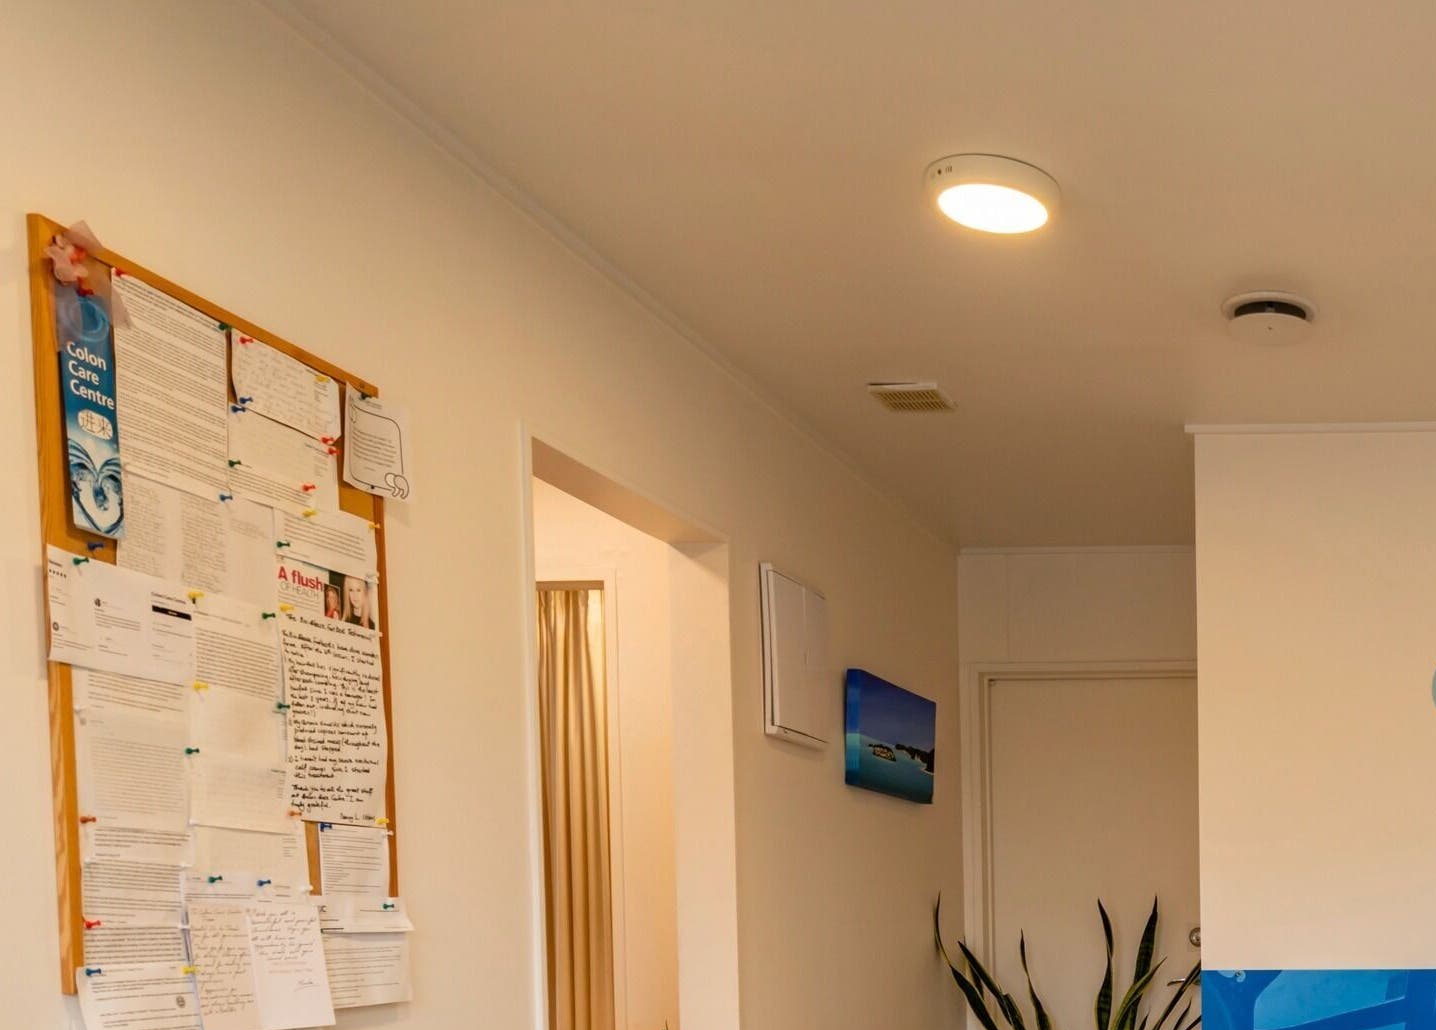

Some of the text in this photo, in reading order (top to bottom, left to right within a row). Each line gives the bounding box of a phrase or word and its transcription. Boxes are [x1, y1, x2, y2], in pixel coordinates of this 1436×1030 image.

[67, 341, 107, 371] Colon
[68, 360, 99, 385] Care
[70, 379, 115, 410] Centre
[278, 566, 323, 592] A flush
[280, 581, 319, 600] OF HEALTH
